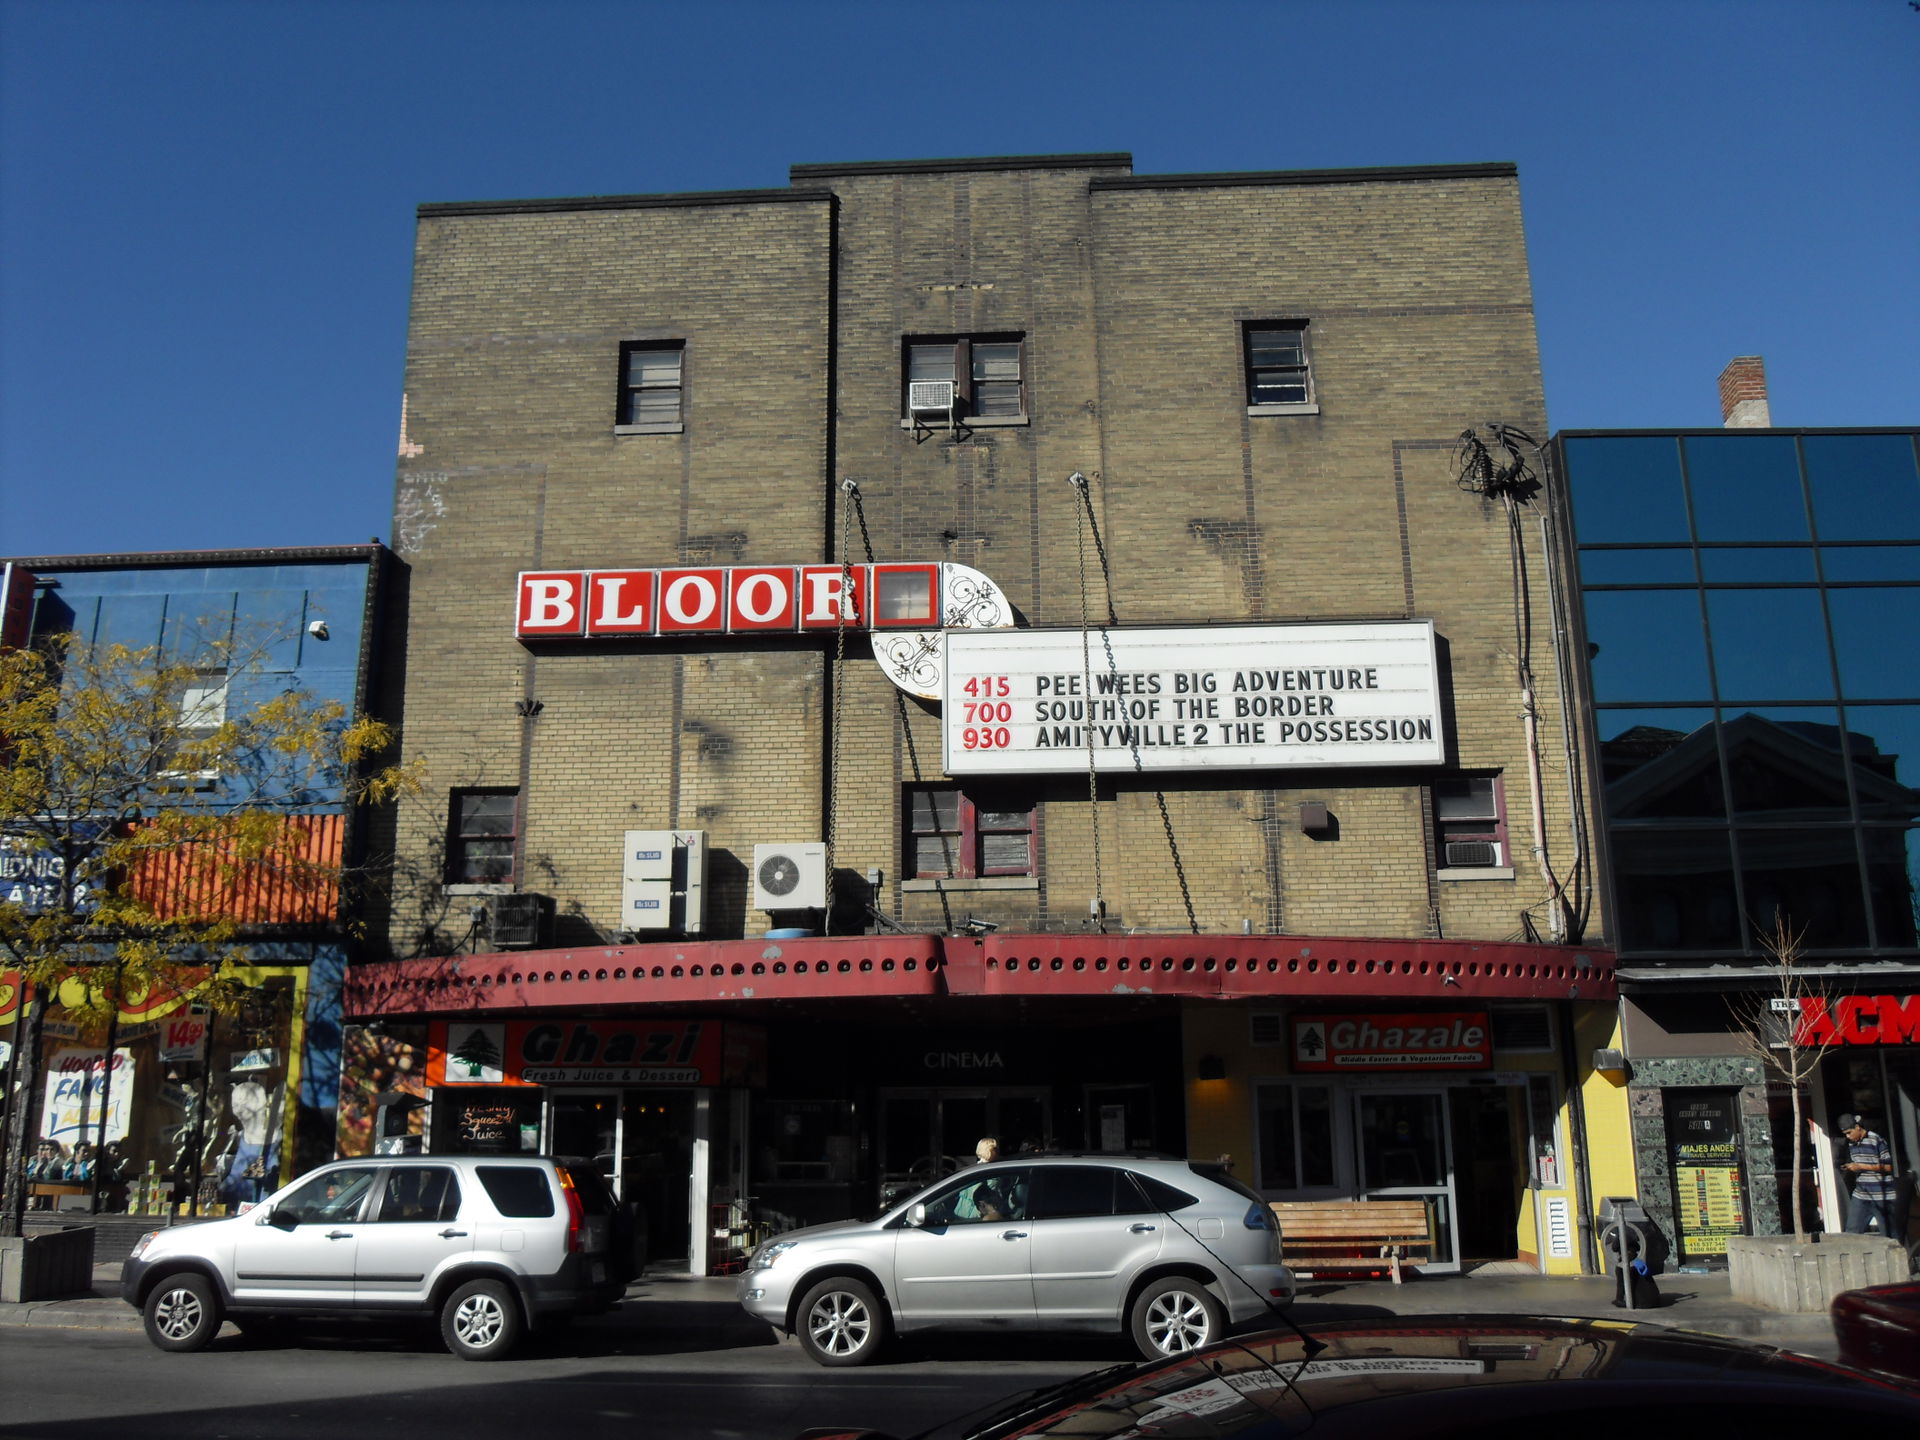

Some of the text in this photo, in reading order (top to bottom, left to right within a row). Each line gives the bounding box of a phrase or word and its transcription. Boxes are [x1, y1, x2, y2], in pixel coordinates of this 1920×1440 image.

[522, 572, 858, 628] BLOOR
[962, 668, 1379, 699] 415 PEE WEES BIG ADVENTURE
[963, 695, 1335, 724] 700 SOUTH OF THE BORDER
[962, 718, 1433, 750] 930 AMITYVILLE 2 THE POSSESSION
[522, 1023, 702, 1064] Ghazi
[1330, 1020, 1483, 1049] Ghazale
[524, 1068, 699, 1081] Fresh Juice & Dessert
[924, 1051, 1004, 1069] CINEMA
[463, 1127, 505, 1140] Juice
[1709, 1144, 1735, 1152] ANDES
